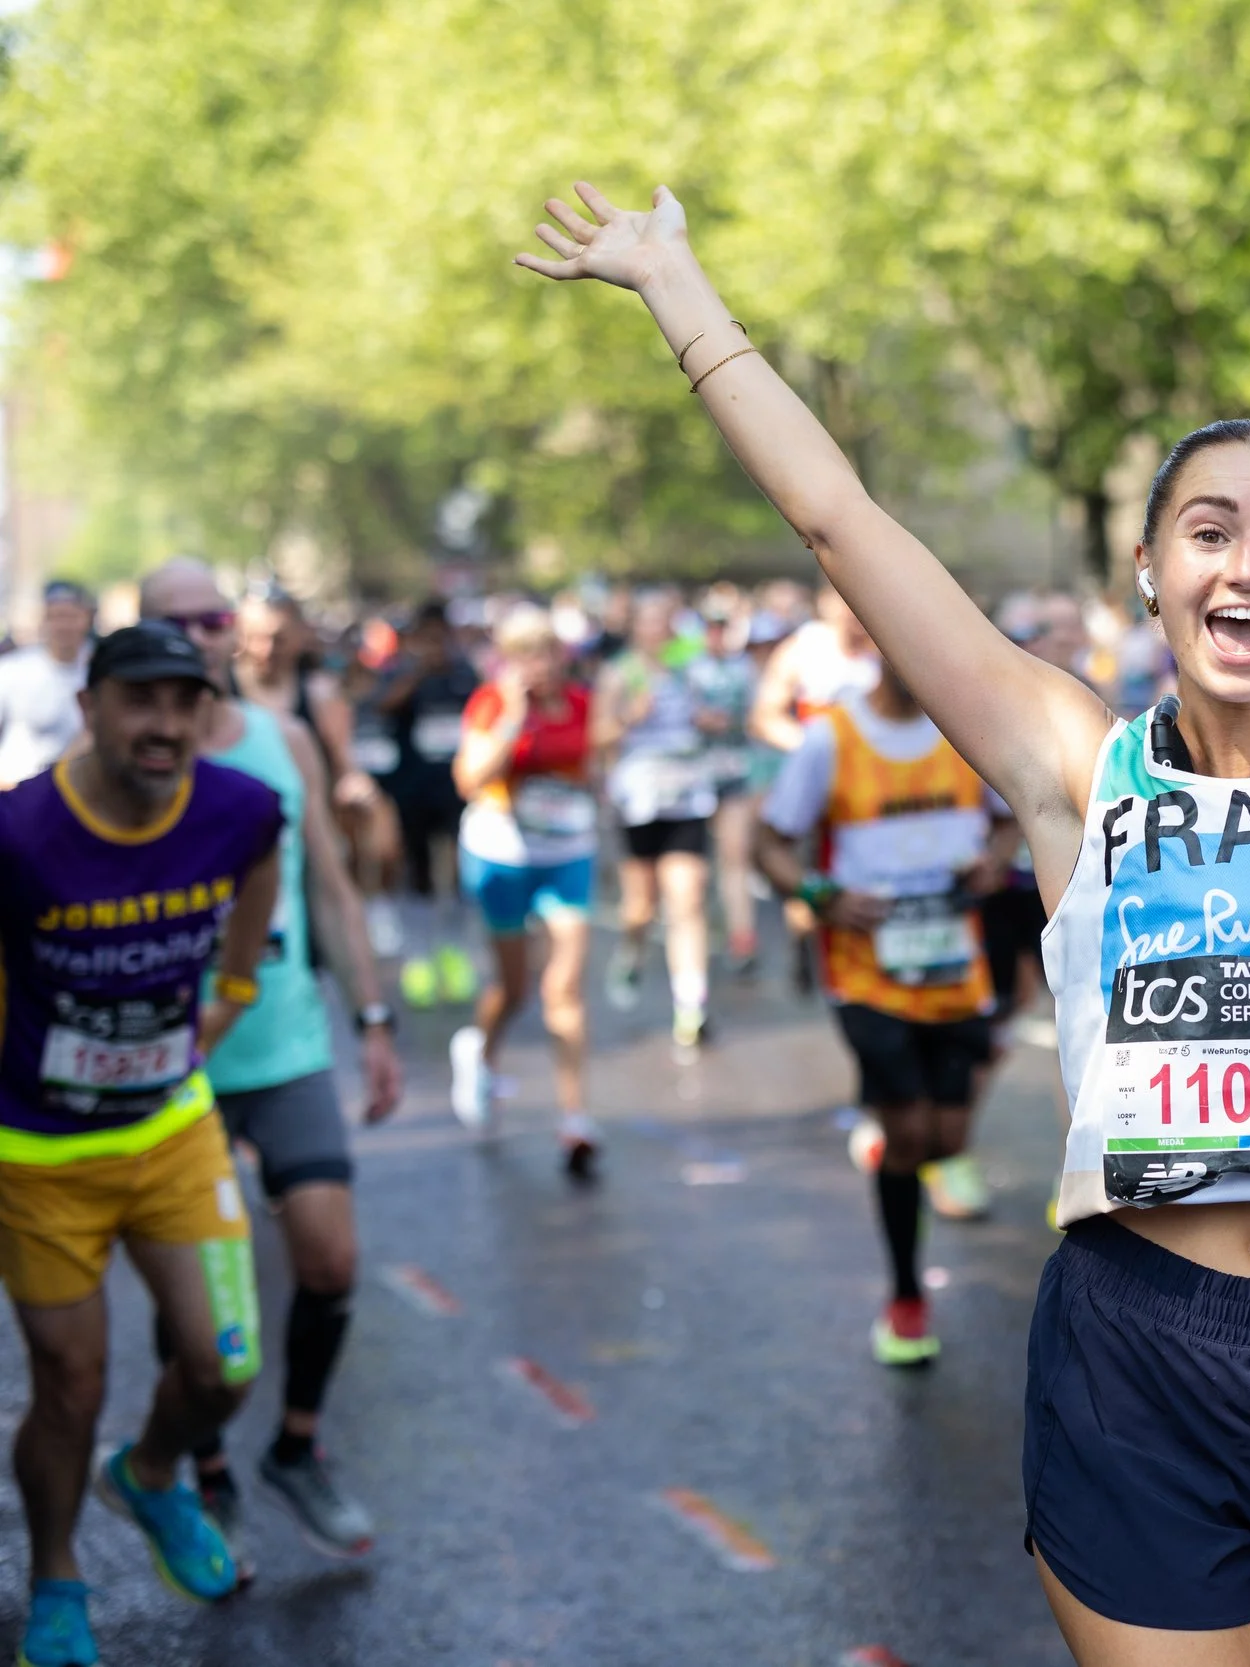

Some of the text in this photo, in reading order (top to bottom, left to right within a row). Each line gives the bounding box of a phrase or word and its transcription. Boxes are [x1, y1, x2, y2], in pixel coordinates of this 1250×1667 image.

[35, 876, 234, 932] JONATHAN
[1118, 896, 1201, 968] Sue
[1123, 970, 1208, 1025] tcs
[1158, 1138, 1185, 1146] MEDAL
